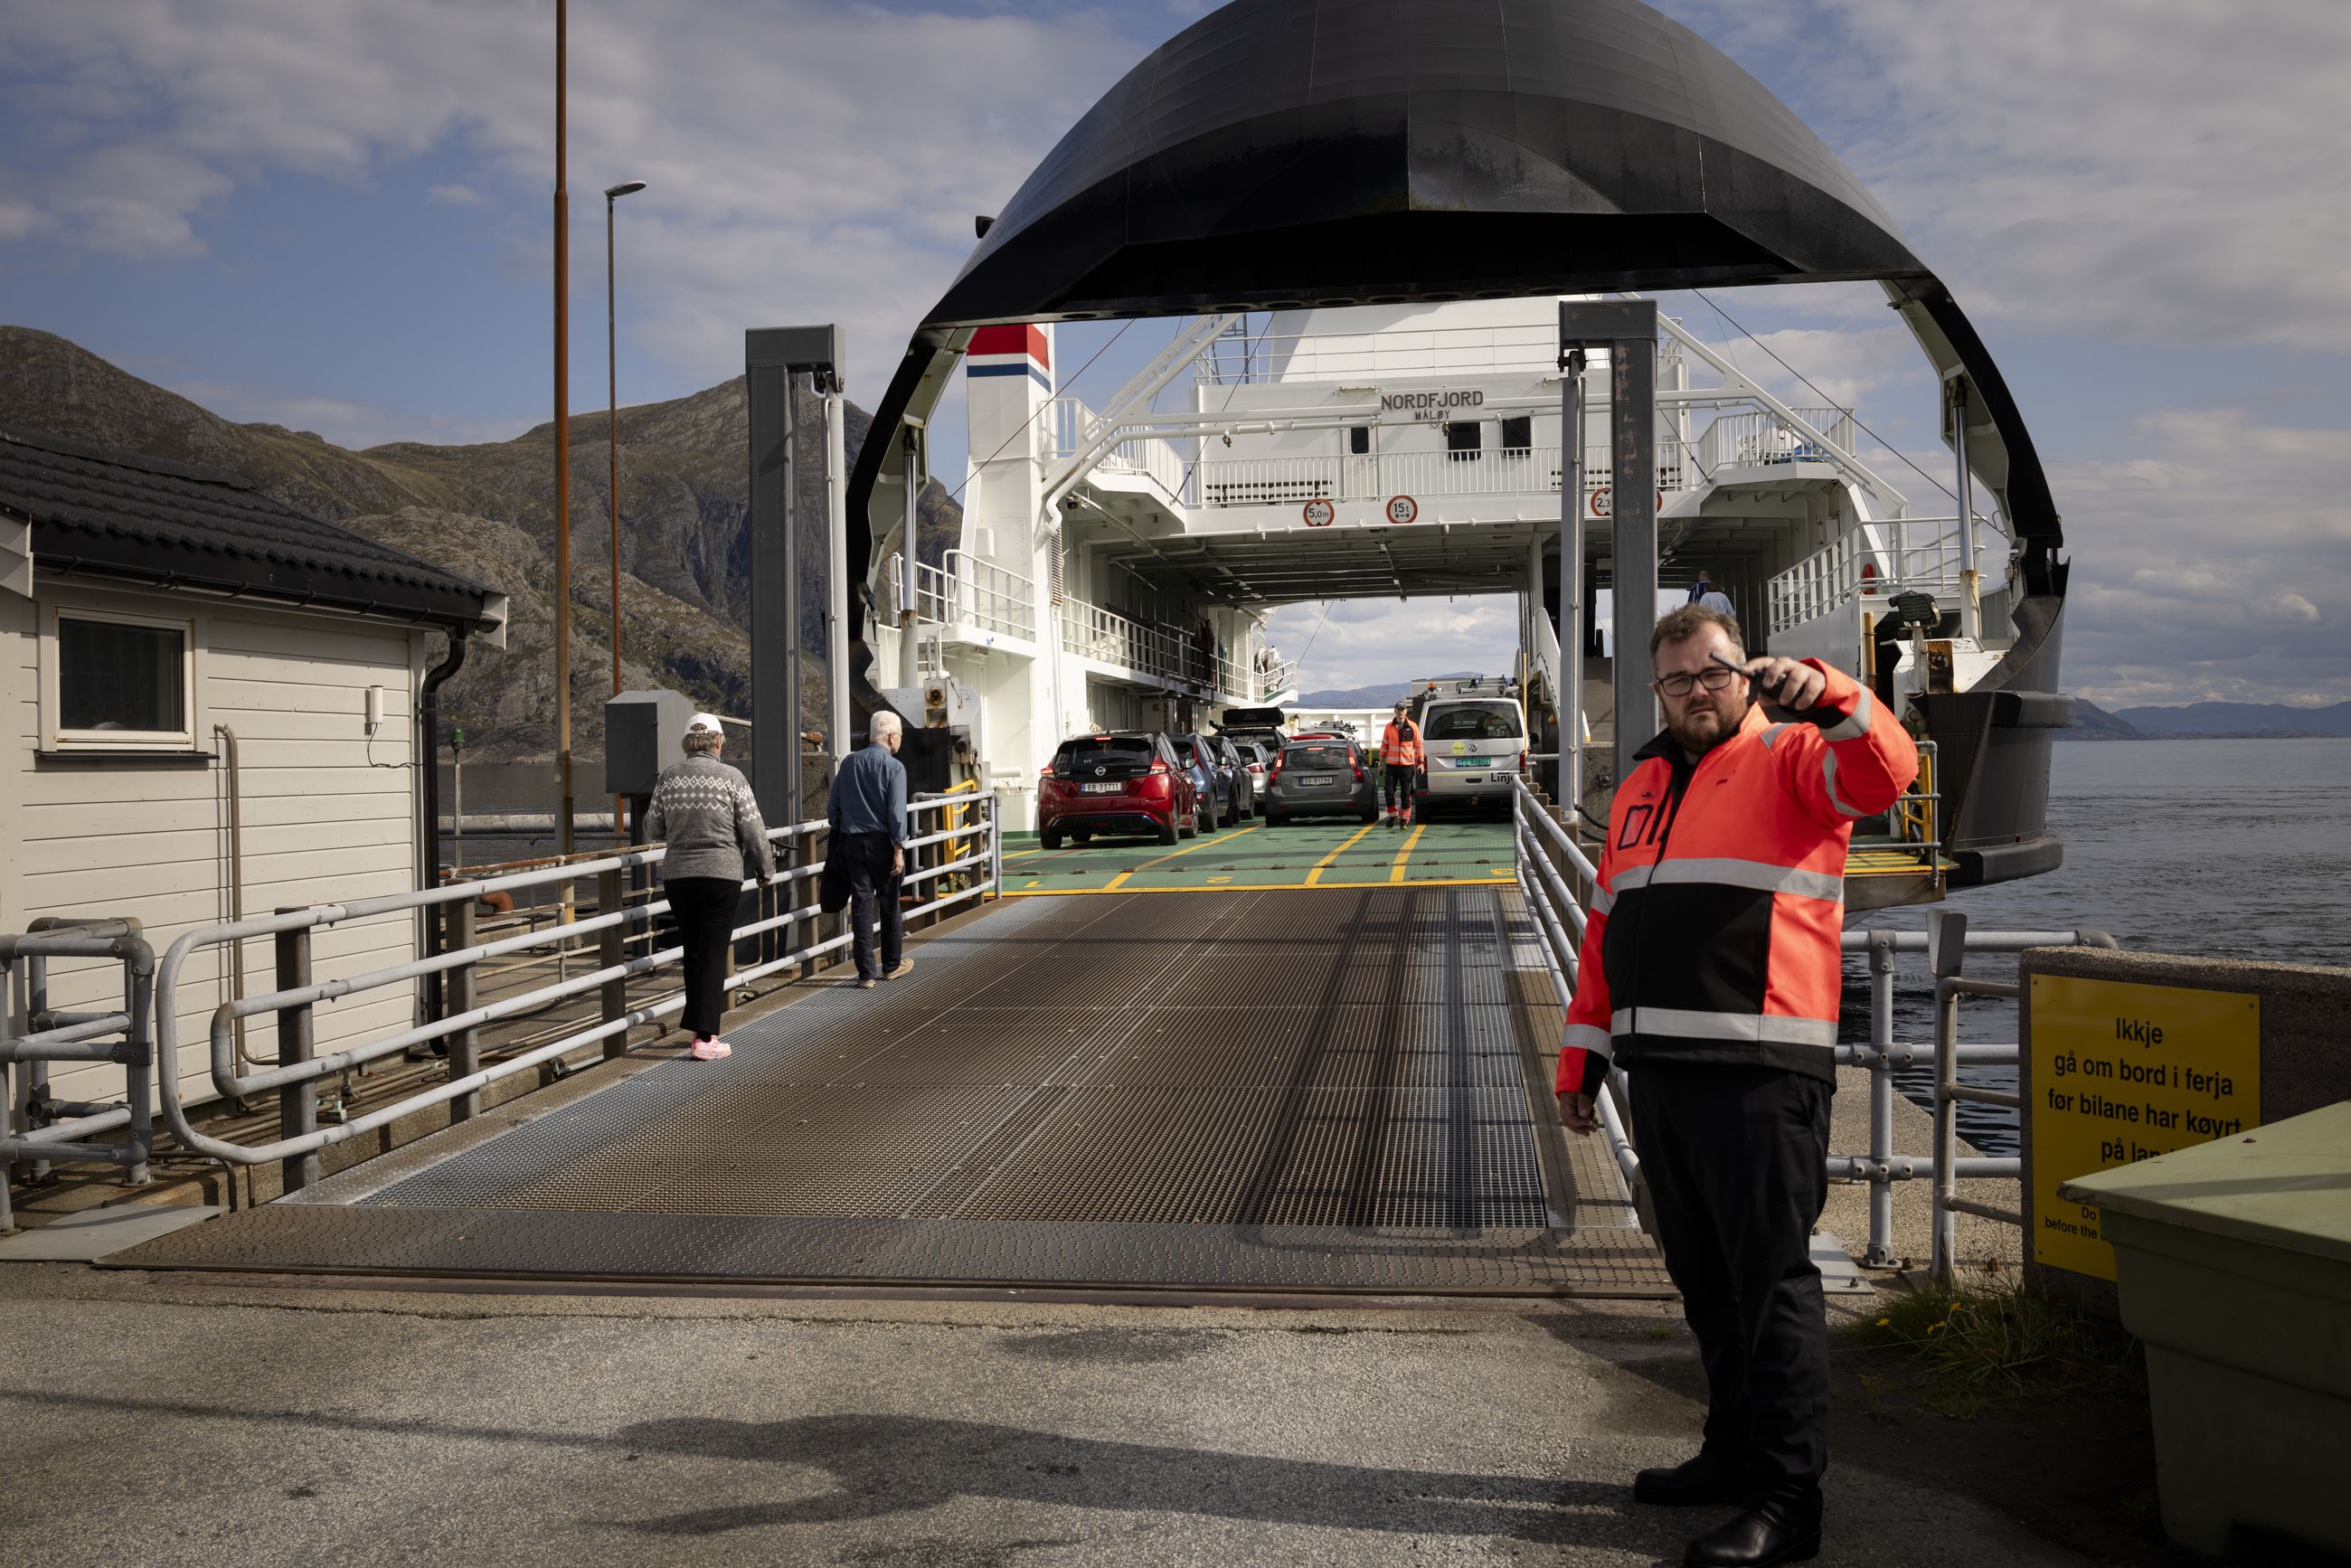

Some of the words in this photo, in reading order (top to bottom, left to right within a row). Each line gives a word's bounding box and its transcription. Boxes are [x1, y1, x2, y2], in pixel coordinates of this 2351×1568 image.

[1381, 391, 1483, 411] NORDFJORD
[1414, 409, 1450, 420] MÅLØY
[1393, 502, 1405, 514] 15
[1099, 783, 1119, 791] 33711
[2116, 1017, 2164, 1048] Ikkje
[2054, 1051, 2077, 1076] gå
[2083, 1058, 2113, 1079] om
[2120, 1059, 2166, 1086] bord
[2173, 1066, 2178, 1088] i
[2185, 1068, 2233, 1100] ferja
[2048, 1088, 2074, 1111] før
[2080, 1093, 2139, 1123] bilane
[2146, 1103, 2180, 1129] har
[2186, 1110, 2242, 1140] køyrt
[2101, 1138, 2125, 1163] på
[2132, 1142, 2175, 1163] la
[2082, 1206, 2097, 1221] Do
[2045, 1216, 2078, 1234] before
[2081, 1224, 2098, 1239] the
